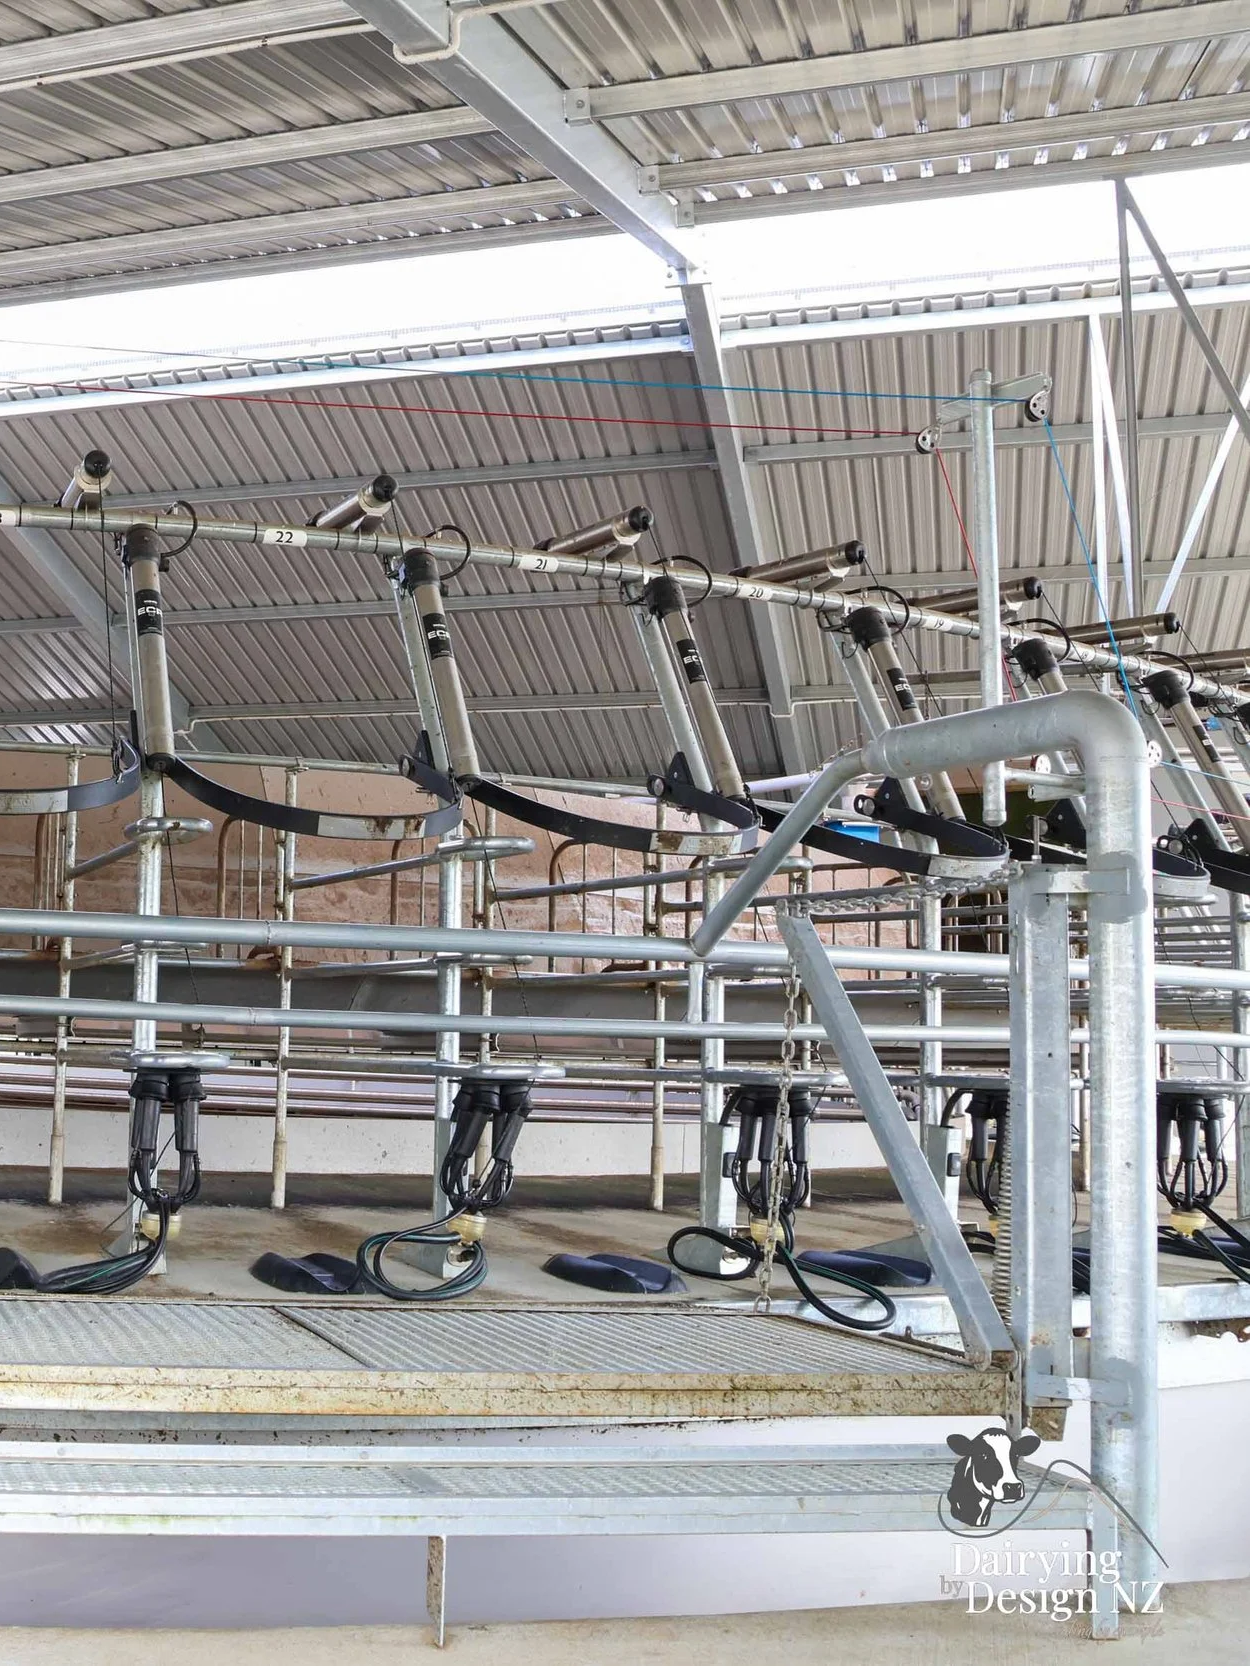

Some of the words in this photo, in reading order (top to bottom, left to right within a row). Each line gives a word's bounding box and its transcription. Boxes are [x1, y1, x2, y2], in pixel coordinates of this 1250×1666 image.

[275, 530, 294, 543] 22
[534, 558, 548, 570] 21
[748, 586, 764, 598] 20
[934, 618, 945, 629] 19
[683, 655, 700, 664] EC
[894, 683, 911, 692] EC
